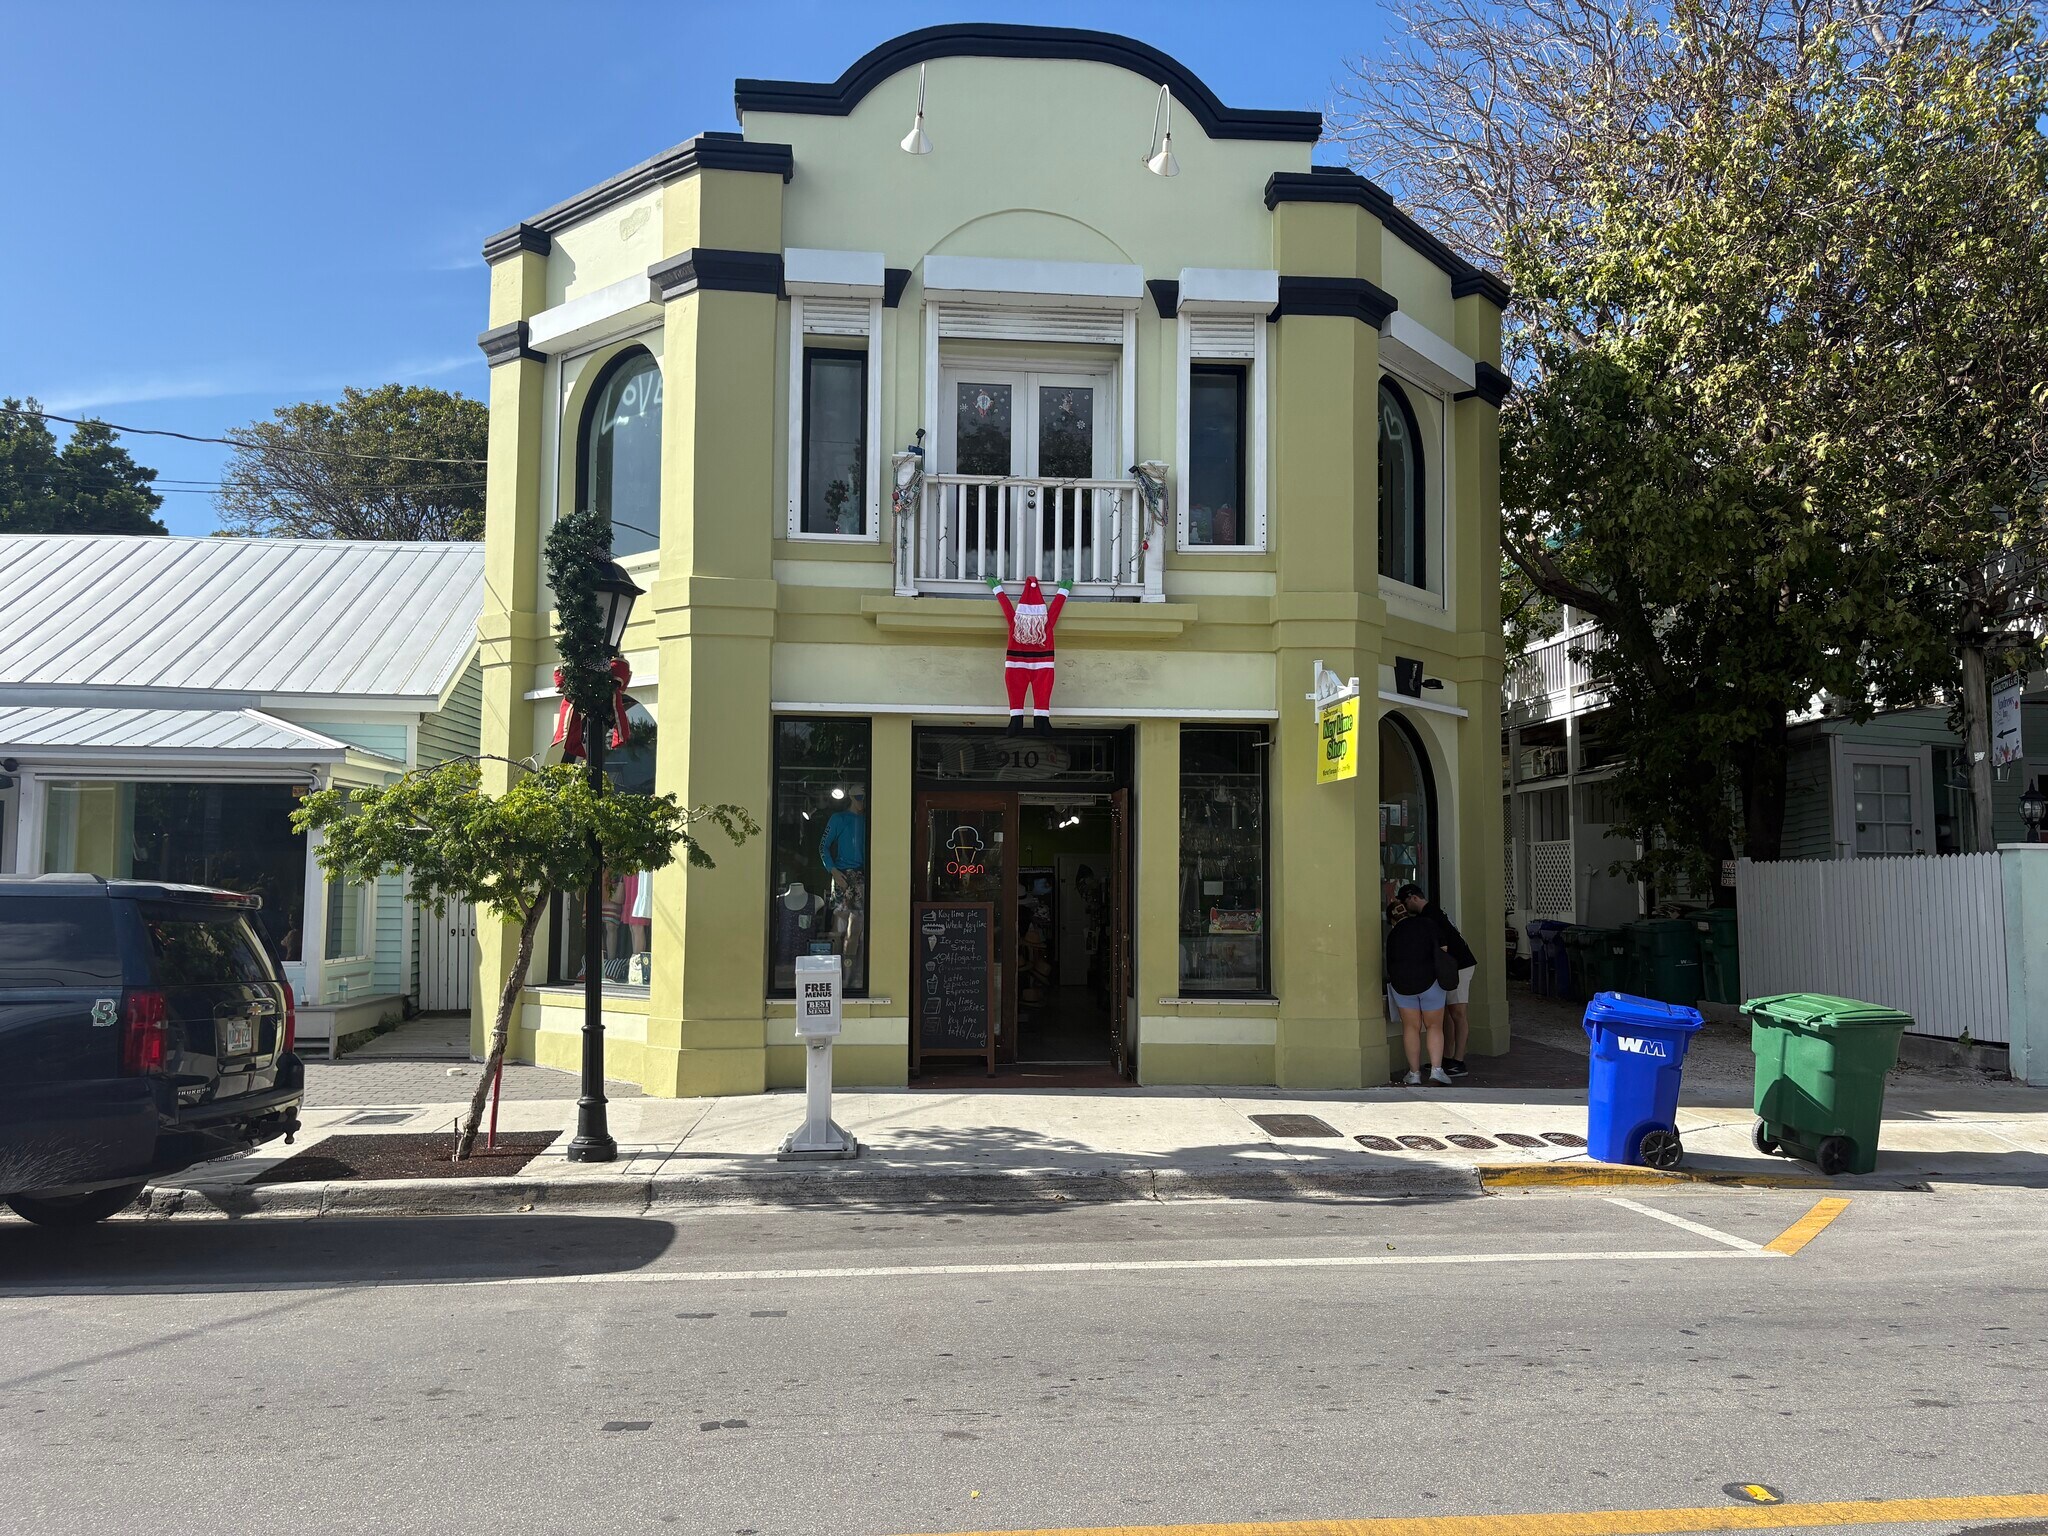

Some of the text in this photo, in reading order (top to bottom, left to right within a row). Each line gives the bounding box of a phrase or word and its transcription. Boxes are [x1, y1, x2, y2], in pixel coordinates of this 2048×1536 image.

[1323, 713, 1353, 739] Key Lime
[996, 750, 1040, 768] 910
[1327, 738, 1347, 760] Shop
[946, 861, 985, 879] Open
[805, 983, 832, 992] FREE
[91, 998, 118, 1027] B
[1617, 1036, 1666, 1058] WM
